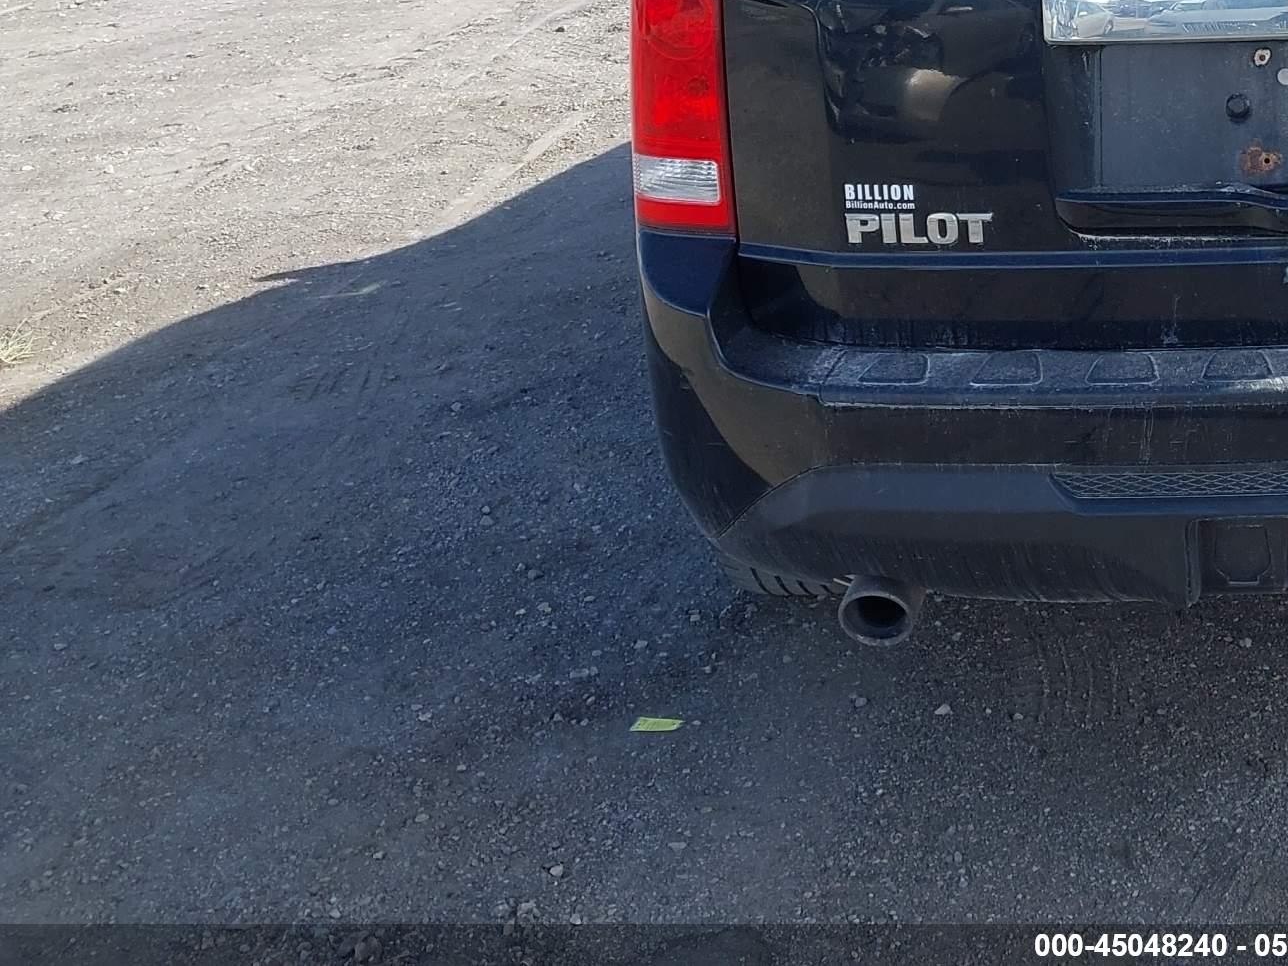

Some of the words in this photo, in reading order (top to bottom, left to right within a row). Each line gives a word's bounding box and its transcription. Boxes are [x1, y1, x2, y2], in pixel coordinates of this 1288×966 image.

[844, 184, 914, 201] BILLION
[845, 200, 916, 210] BillionAuto.com
[844, 212, 994, 244] PILOT
